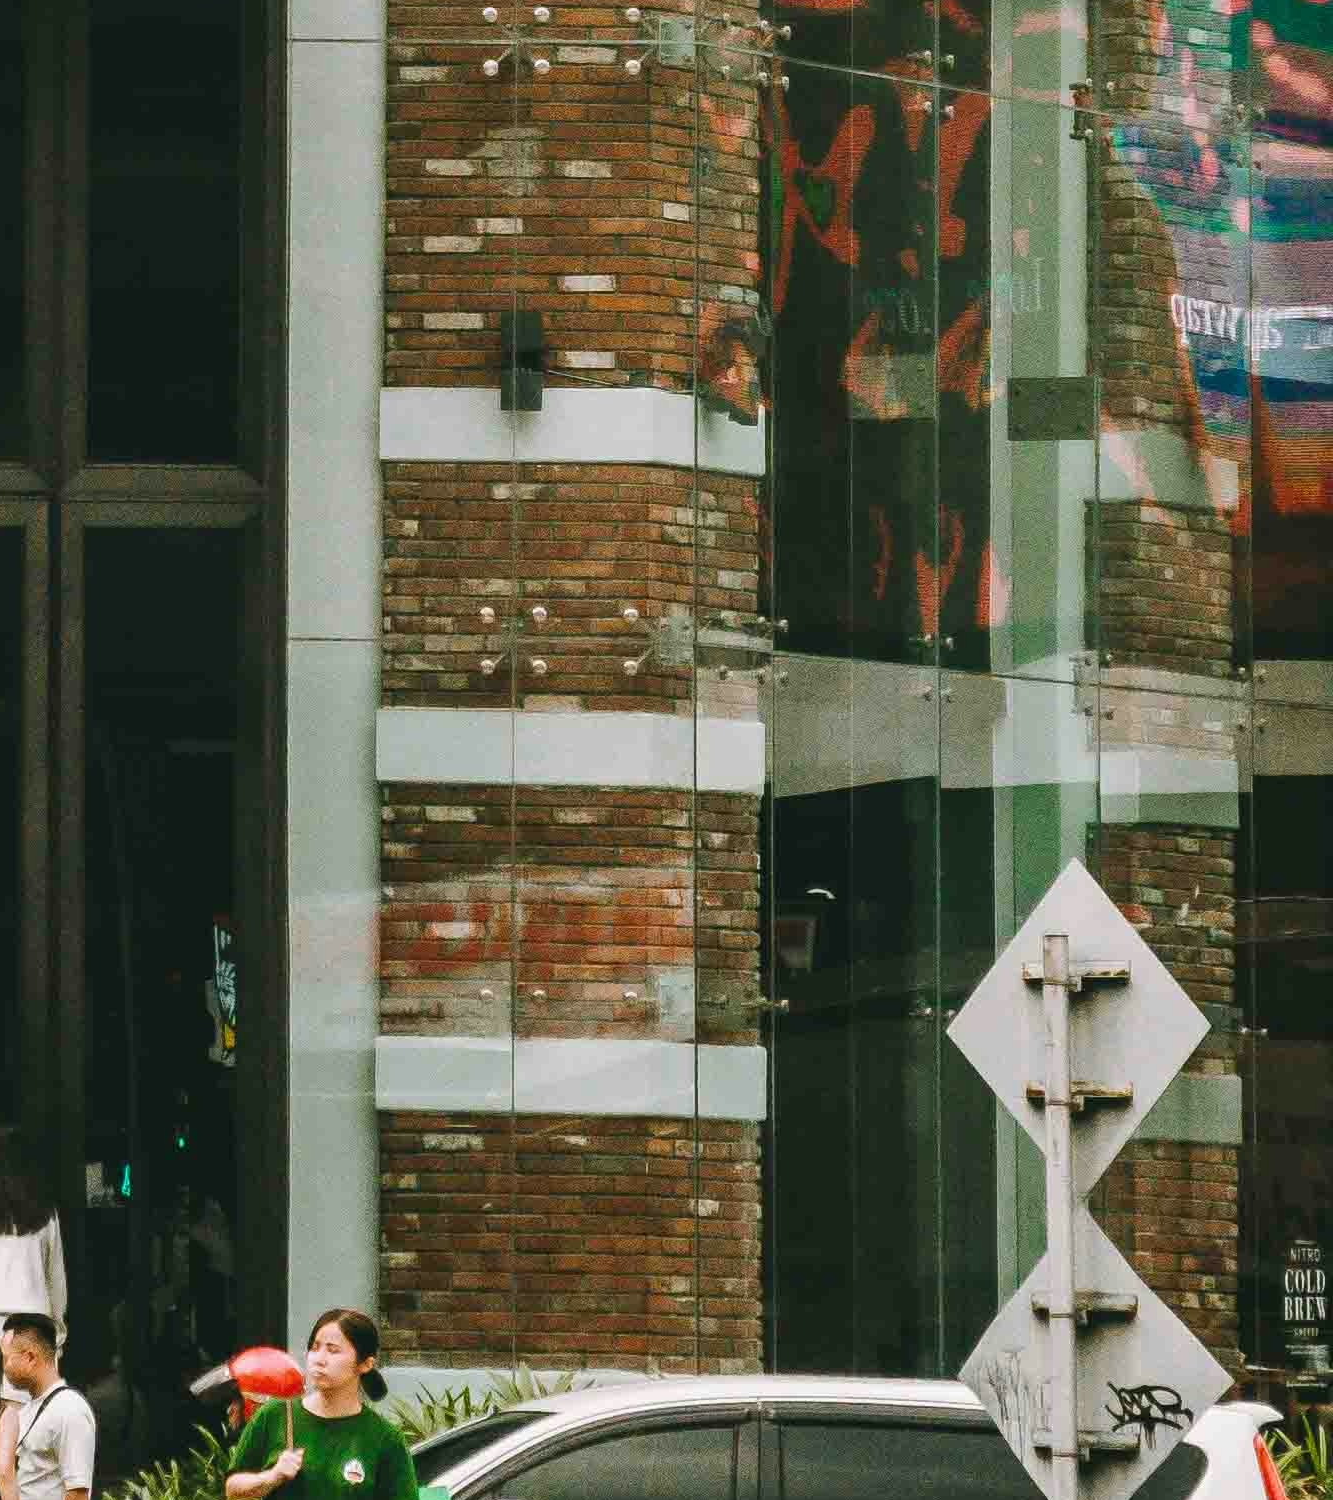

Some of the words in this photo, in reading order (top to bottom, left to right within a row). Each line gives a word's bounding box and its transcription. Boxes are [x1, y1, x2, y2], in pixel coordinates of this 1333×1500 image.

[1290, 1247, 1321, 1263] NITRO
[1283, 1268, 1326, 1294] COLD
[1283, 1296, 1326, 1321] BREW
